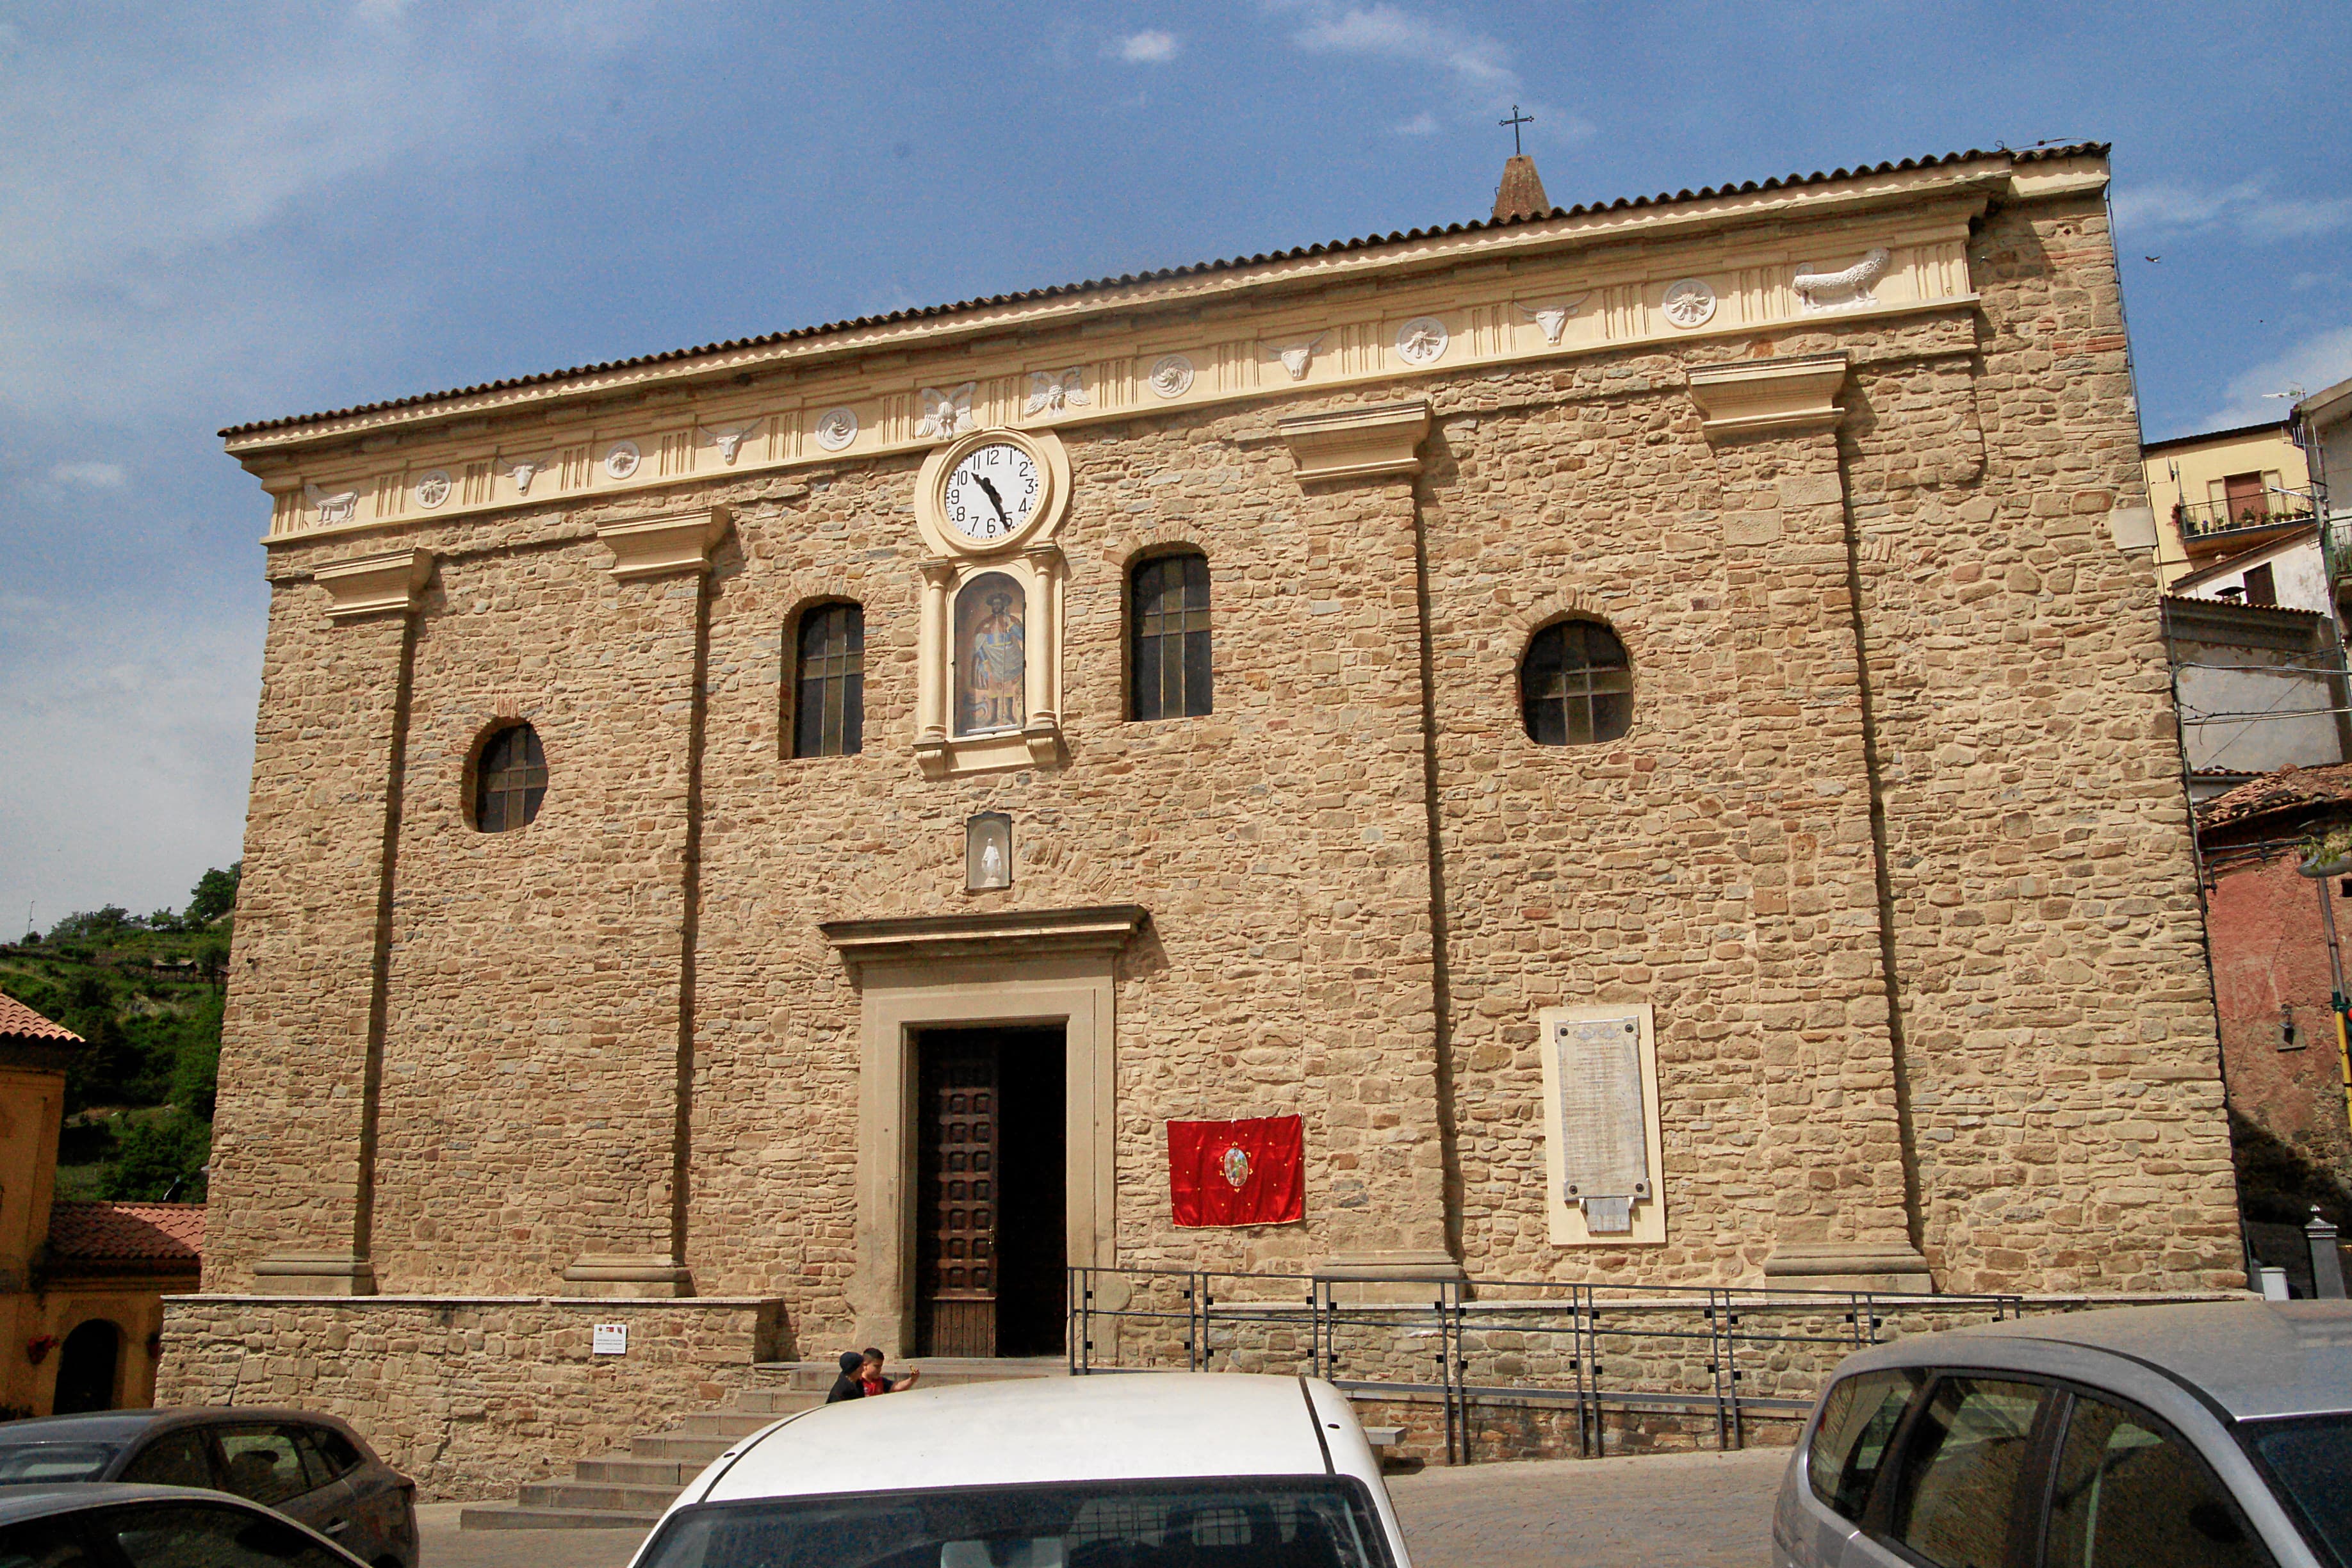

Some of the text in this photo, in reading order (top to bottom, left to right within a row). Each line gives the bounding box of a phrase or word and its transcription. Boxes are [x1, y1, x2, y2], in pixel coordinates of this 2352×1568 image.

[974, 455, 980, 470] 11
[987, 450, 999, 466] 12
[1019, 461, 1028, 477] 2
[957, 470, 967, 486] 10
[1025, 478, 1034, 494] 3
[951, 489, 960, 504] 9
[1018, 498, 1027, 513] 4
[957, 507, 965, 521] 8
[1005, 512, 1013, 527] 5
[971, 516, 979, 532] 7
[987, 518, 995, 533] 6
